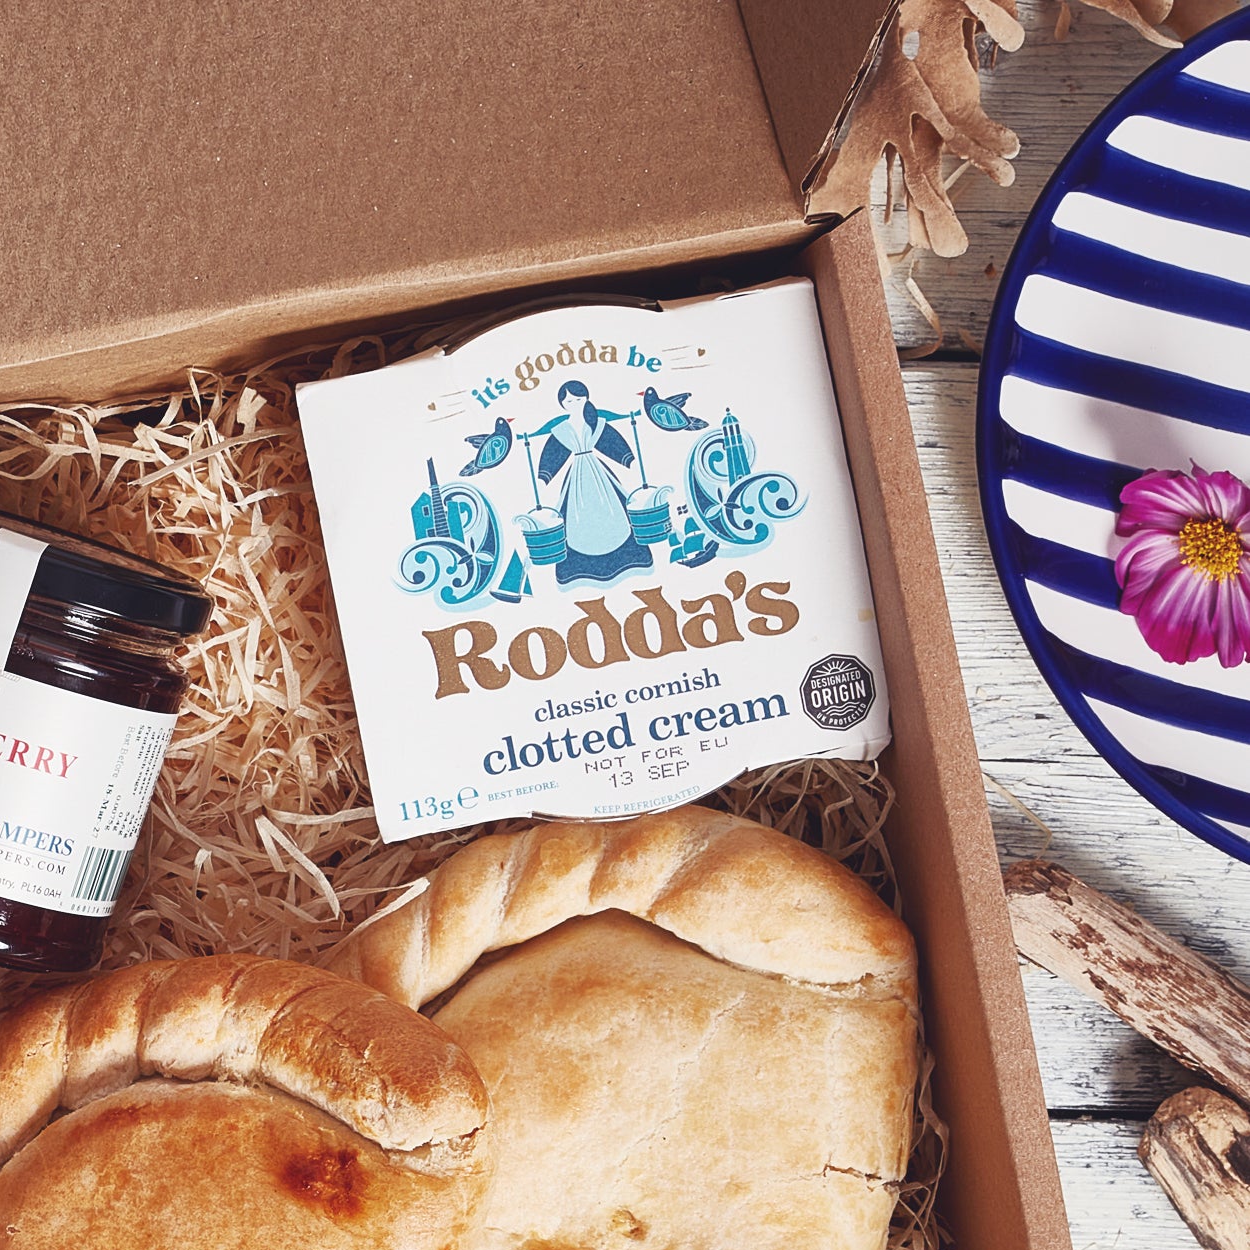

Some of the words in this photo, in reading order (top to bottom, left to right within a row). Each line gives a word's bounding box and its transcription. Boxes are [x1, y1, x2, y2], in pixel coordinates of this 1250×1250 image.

[471, 376, 511, 409] it's
[515, 339, 619, 391] godda
[627, 345, 662, 372] be
[422, 570, 800, 699] Rodda's
[811, 670, 861, 689] DESIGNATED
[811, 680, 866, 708] ORIGIN
[534, 690, 619, 723] classic
[625, 668, 721, 704] cornish
[828, 703, 866, 725] PROTECTED
[483, 712, 636, 776] clotted
[648, 693, 790, 742] cream
[585, 756, 627, 774] NOT
[641, 745, 683, 763] FOR
[700, 737, 729, 752] EU
[609, 771, 634, 788] 13
[648, 760, 690, 780] SEP
[487, 788, 513, 802] BEST
[516, 780, 560, 797] BEFORE:
[594, 803, 623, 815] KEEP
[624, 784, 701, 812] REFRIGERATED
[399, 796, 454, 822] 113g
